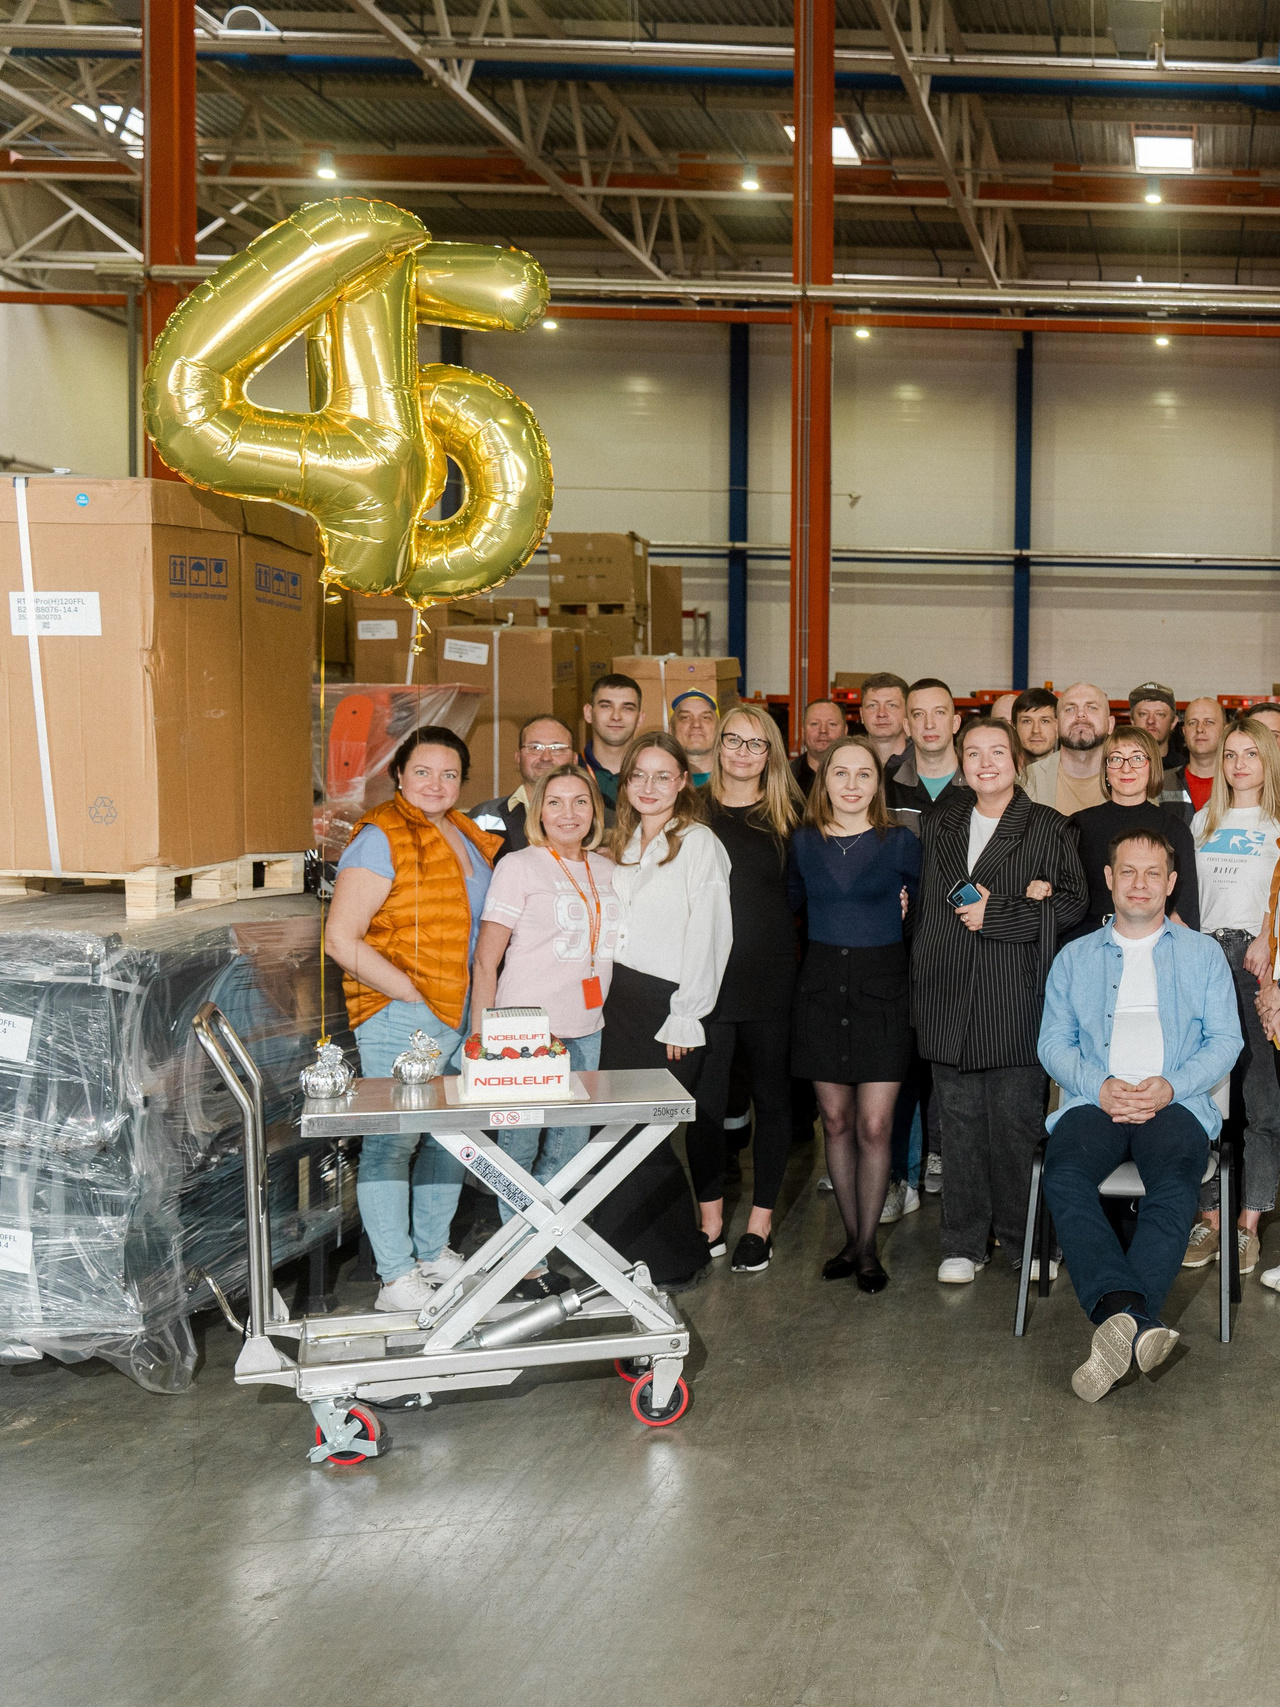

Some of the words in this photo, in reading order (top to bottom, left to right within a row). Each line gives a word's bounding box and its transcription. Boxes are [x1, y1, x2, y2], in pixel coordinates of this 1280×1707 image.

[17, 598, 85, 606] RTPro(H)120FFL
[488, 1033, 546, 1041] NOBLELIFT
[474, 1075, 564, 1086] NOBLELIFT
[653, 1107, 678, 1117] 250kgs
